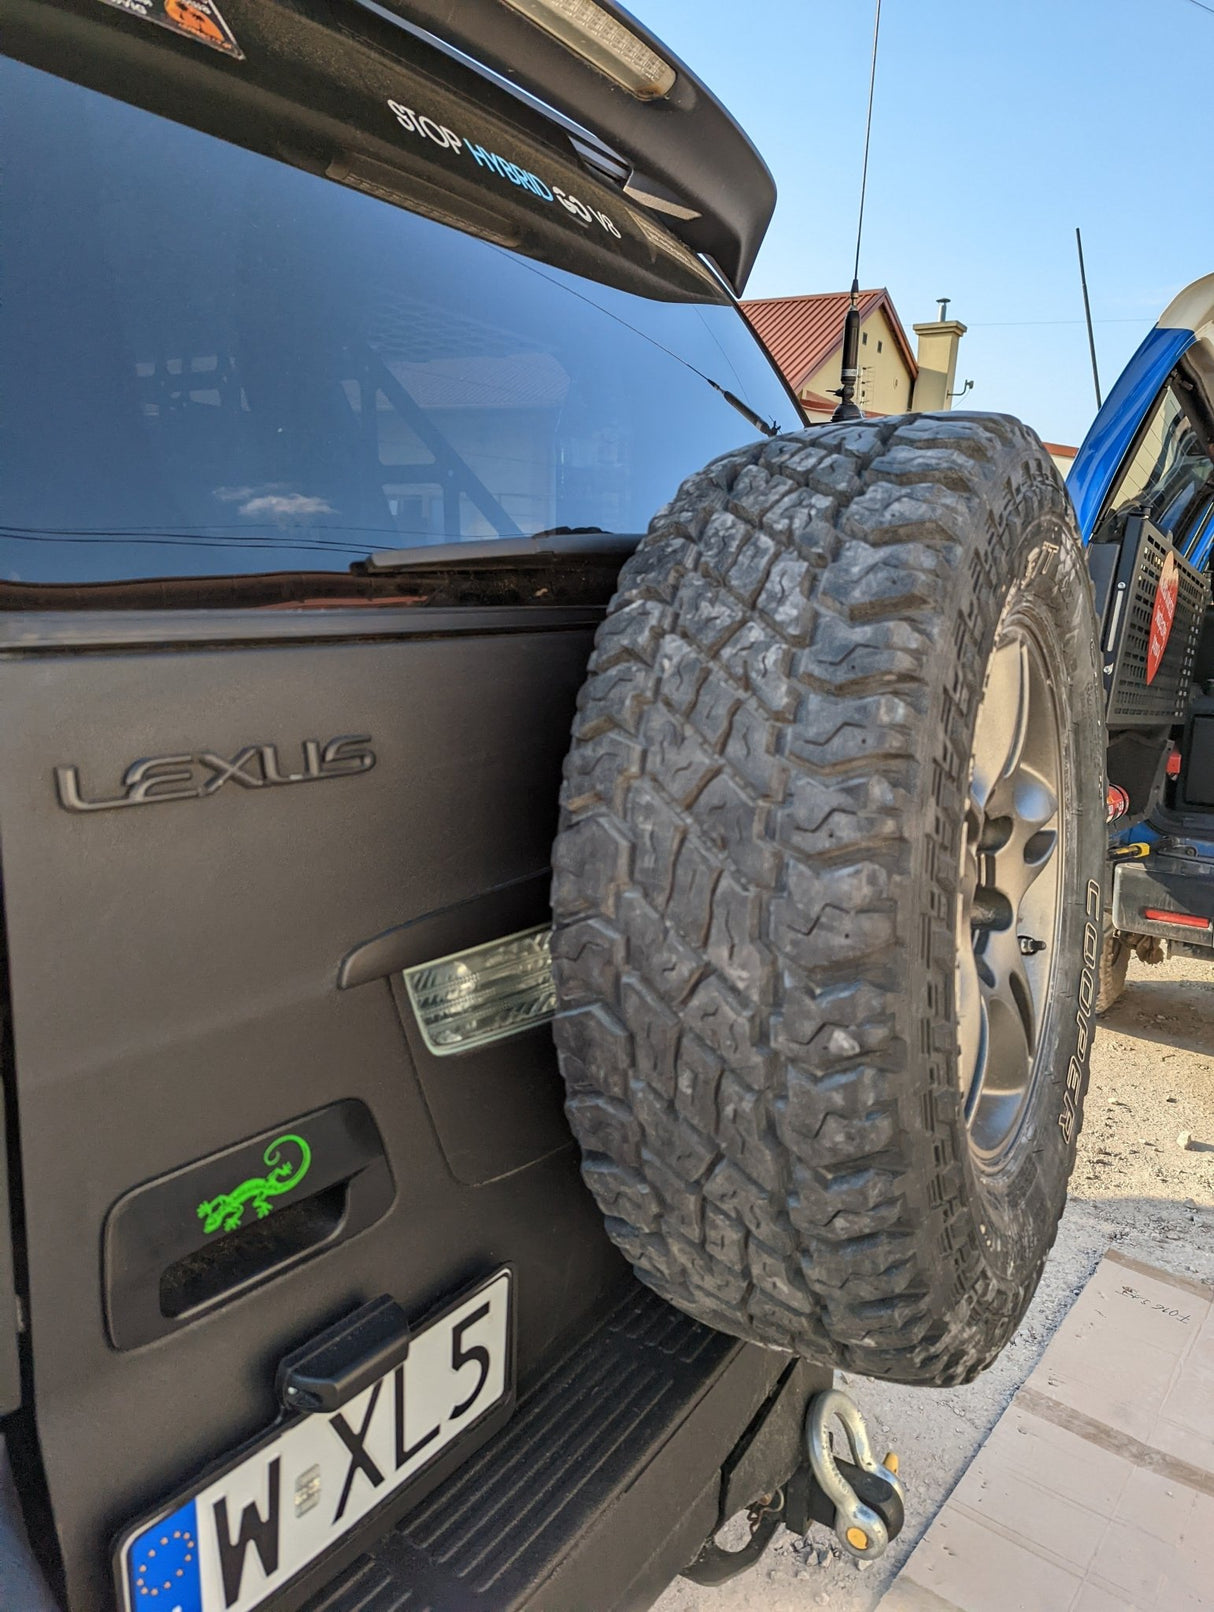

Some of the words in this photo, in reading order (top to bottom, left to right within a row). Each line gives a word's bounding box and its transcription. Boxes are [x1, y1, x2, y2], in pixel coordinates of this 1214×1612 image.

[387, 99, 462, 154] STOP
[463, 138, 554, 202] HYBRID
[552, 186, 592, 223] GO
[586, 204, 622, 239] V8
[53, 734, 377, 814] LEXUS
[1058, 878, 1101, 1145] COOPER
[212, 1454, 282, 1610] W
